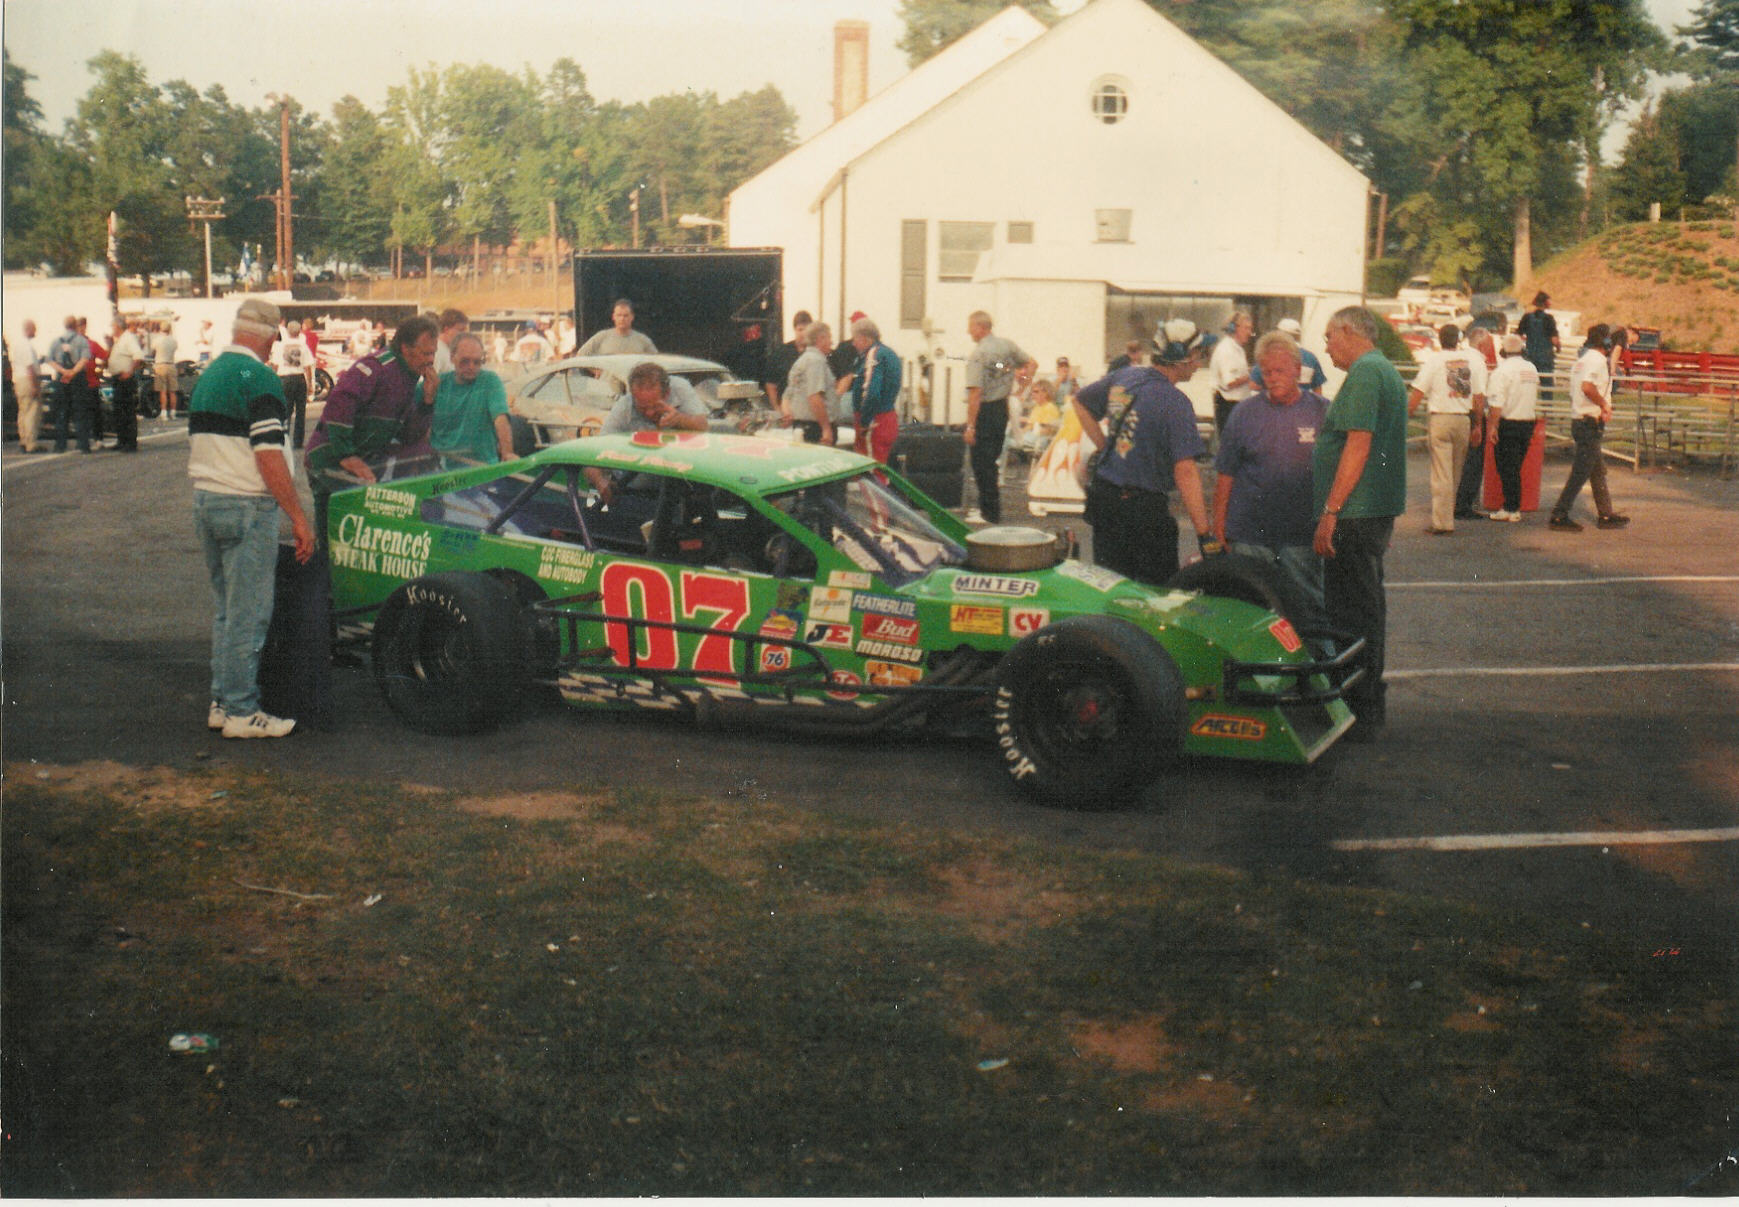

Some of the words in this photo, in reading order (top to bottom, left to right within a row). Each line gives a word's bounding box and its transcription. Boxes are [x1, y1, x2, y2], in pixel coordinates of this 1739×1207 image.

[364, 486, 417, 508] PATTERSON
[338, 513, 432, 561] Clarence's
[333, 546, 377, 573] STEAK
[380, 554, 428, 580] HOUSE
[956, 577, 1037, 597] MINTER
[852, 594, 916, 616] FEATHERLITE
[601, 561, 751, 689] 07
[876, 619, 917, 638] Bud
[1015, 613, 1042, 631] CV
[767, 652, 784, 667] 76
[856, 640, 923, 663] MOROSO
[991, 685, 1037, 780] Hoosier
